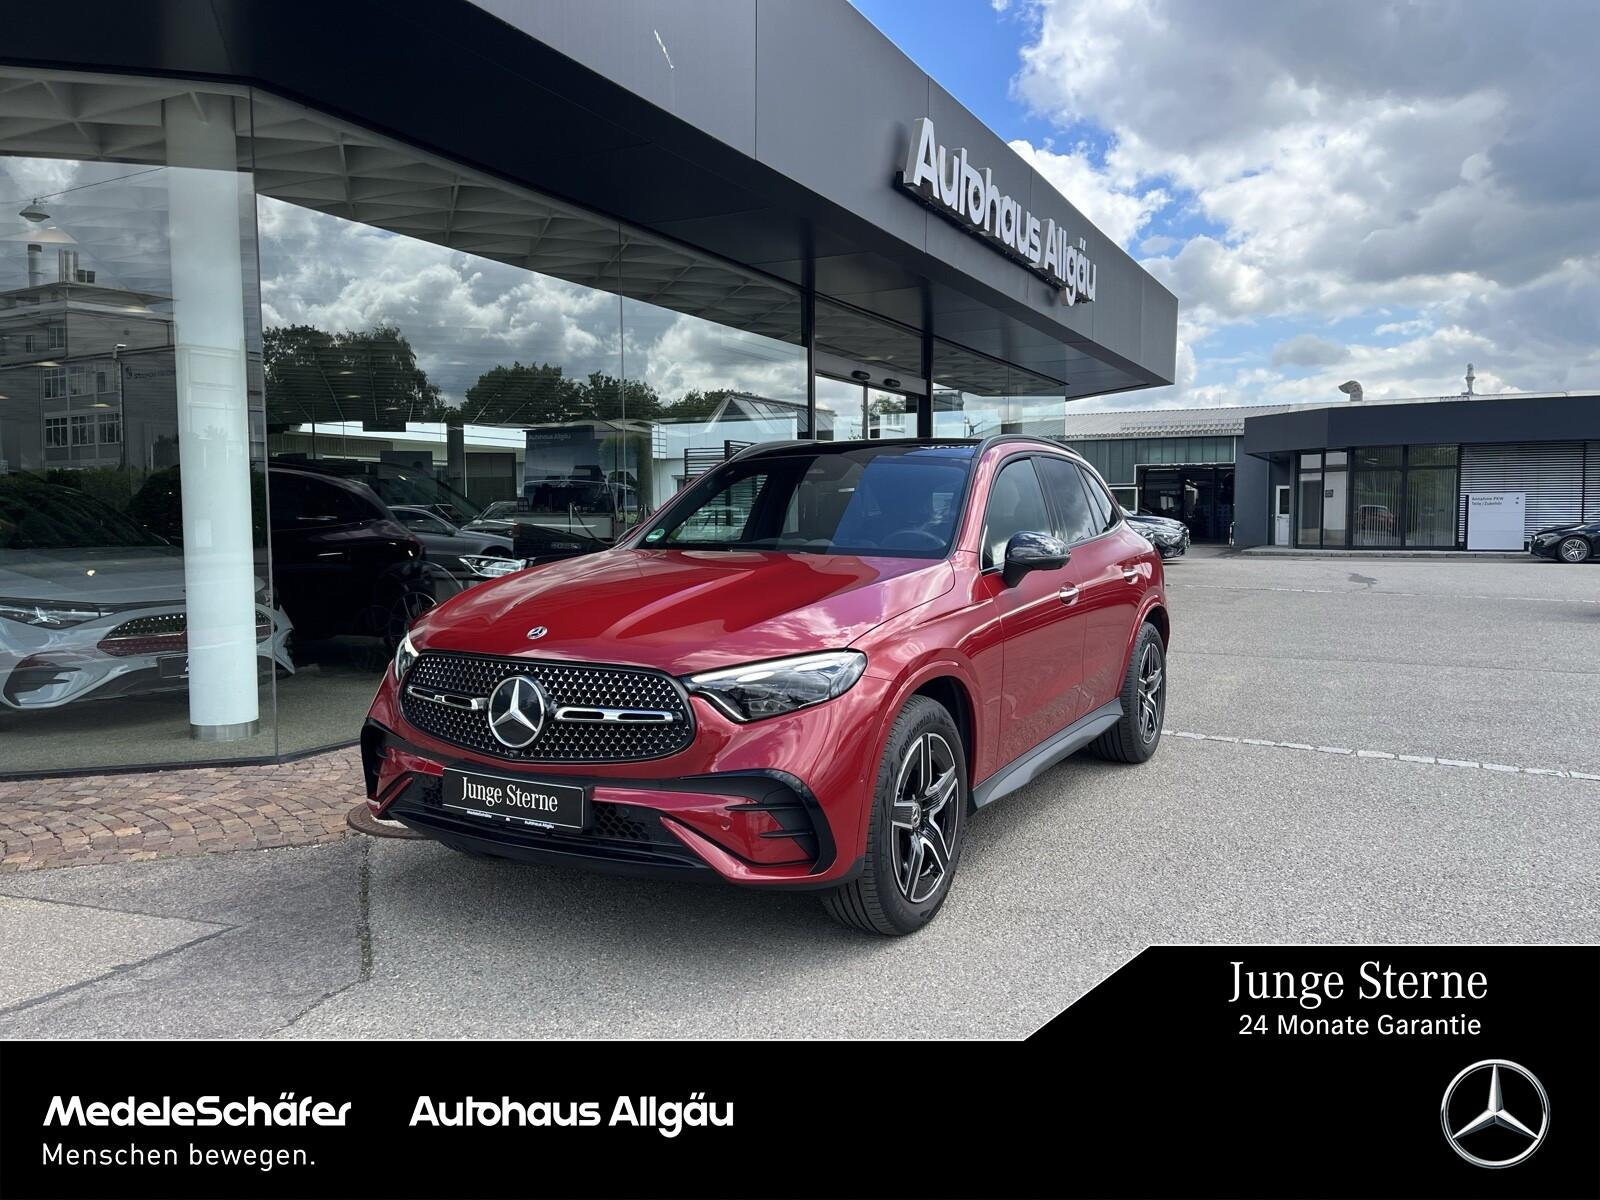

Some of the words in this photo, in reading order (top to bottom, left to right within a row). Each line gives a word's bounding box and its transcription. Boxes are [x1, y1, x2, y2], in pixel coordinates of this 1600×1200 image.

[905, 117, 1041, 263] Autohaus
[1044, 218, 1096, 306] Allgäu
[461, 776, 502, 807] Junge
[506, 784, 558, 812] Sterne
